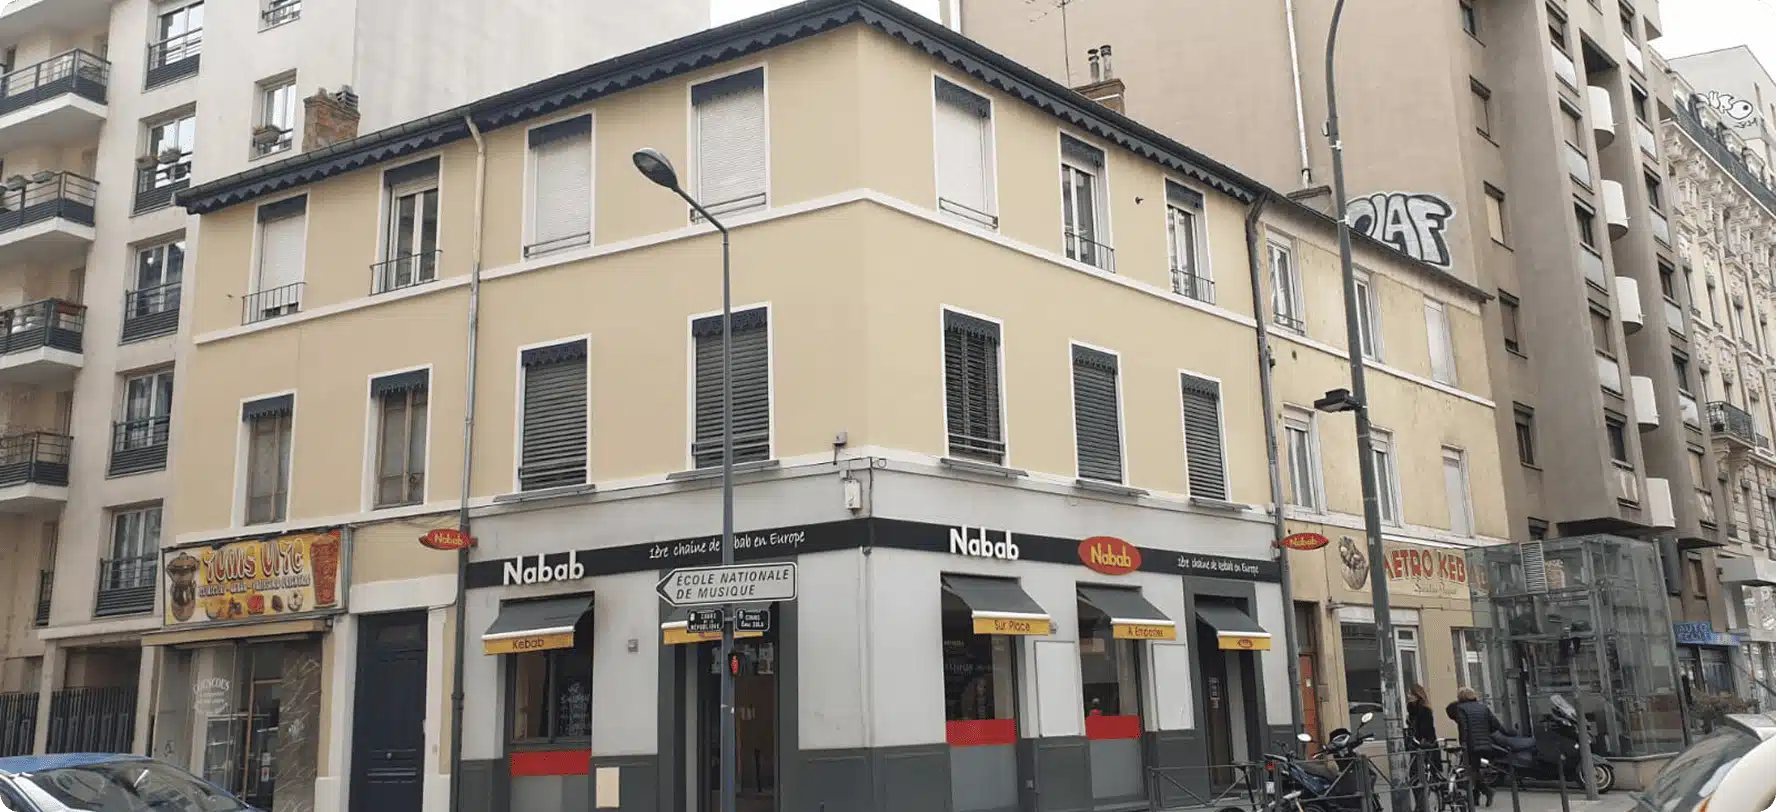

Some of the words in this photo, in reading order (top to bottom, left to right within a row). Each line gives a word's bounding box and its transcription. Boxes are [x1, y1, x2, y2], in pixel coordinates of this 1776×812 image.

[434, 533, 464, 546] Nabab
[649, 545, 669, 559] 1ère
[709, 537, 720, 552] de
[754, 537, 767, 548] en
[769, 531, 806, 548] Europe
[951, 524, 1019, 561] Nabab
[1290, 536, 1317, 546] Nabab
[1090, 543, 1132, 568] Nabab
[503, 549, 585, 586] Nabab
[676, 573, 715, 587] ÉCOLE
[720, 569, 789, 584] NATIONALE
[676, 589, 692, 600] DE
[698, 584, 756, 598] MUSIQUE
[994, 620, 1007, 632] Sur
[1009, 620, 1031, 632] Place
[513, 637, 544, 650] Kebab
